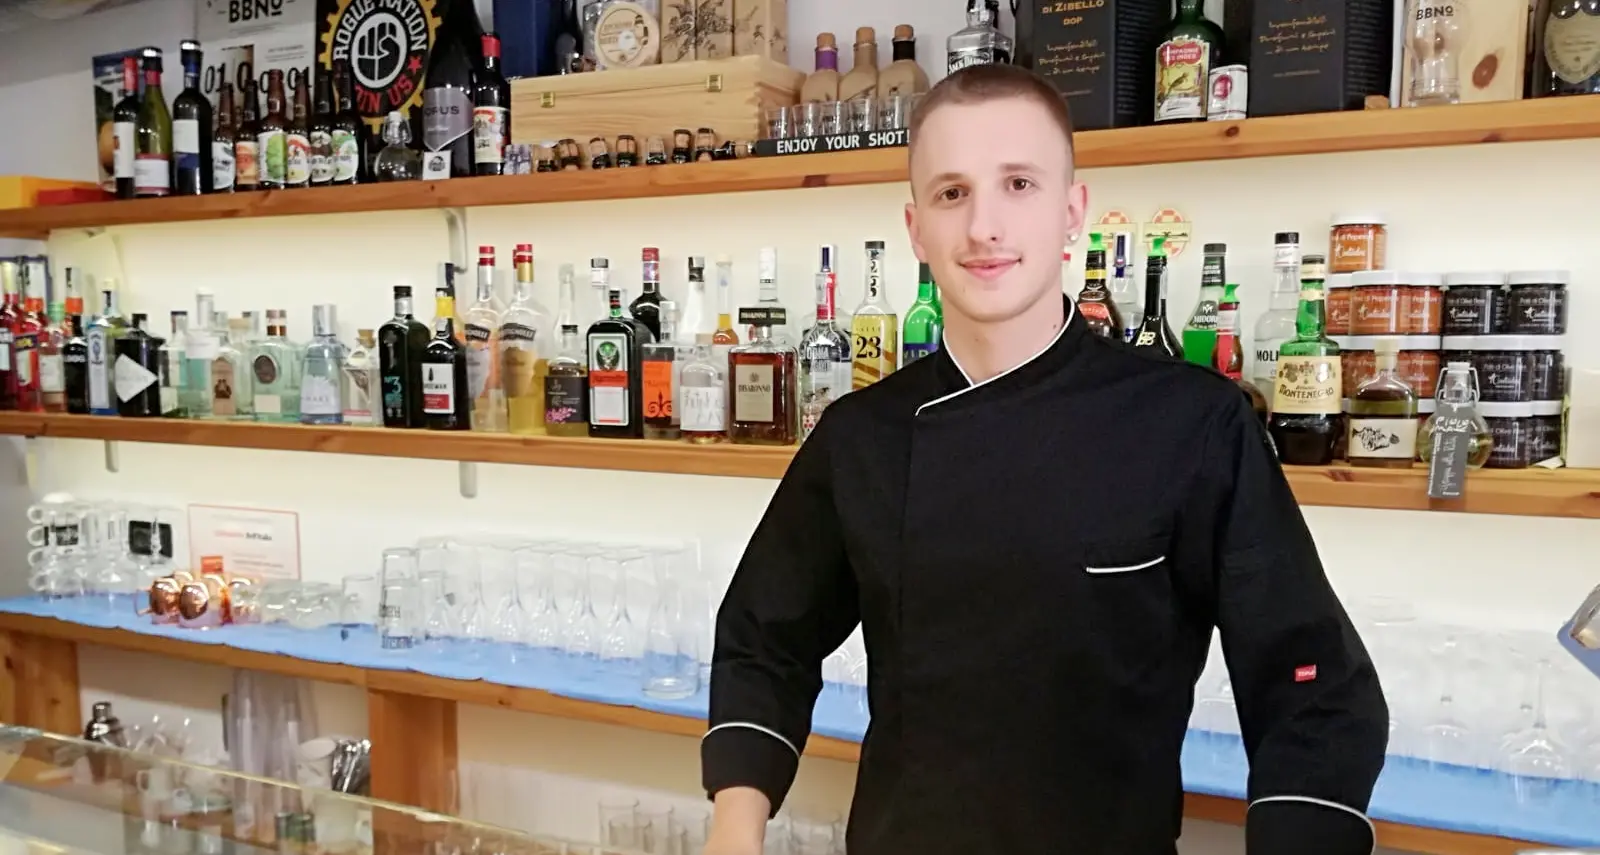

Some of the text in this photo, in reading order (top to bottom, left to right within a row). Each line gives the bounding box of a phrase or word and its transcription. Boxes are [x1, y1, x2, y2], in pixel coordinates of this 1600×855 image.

[1055, 0, 1105, 12] ZIBELLO
[333, 0, 375, 60] ROGUE
[388, 74, 413, 105] US
[777, 130, 909, 154] ENJOY YOUR SHOT!
[856, 336, 882, 358] 23
